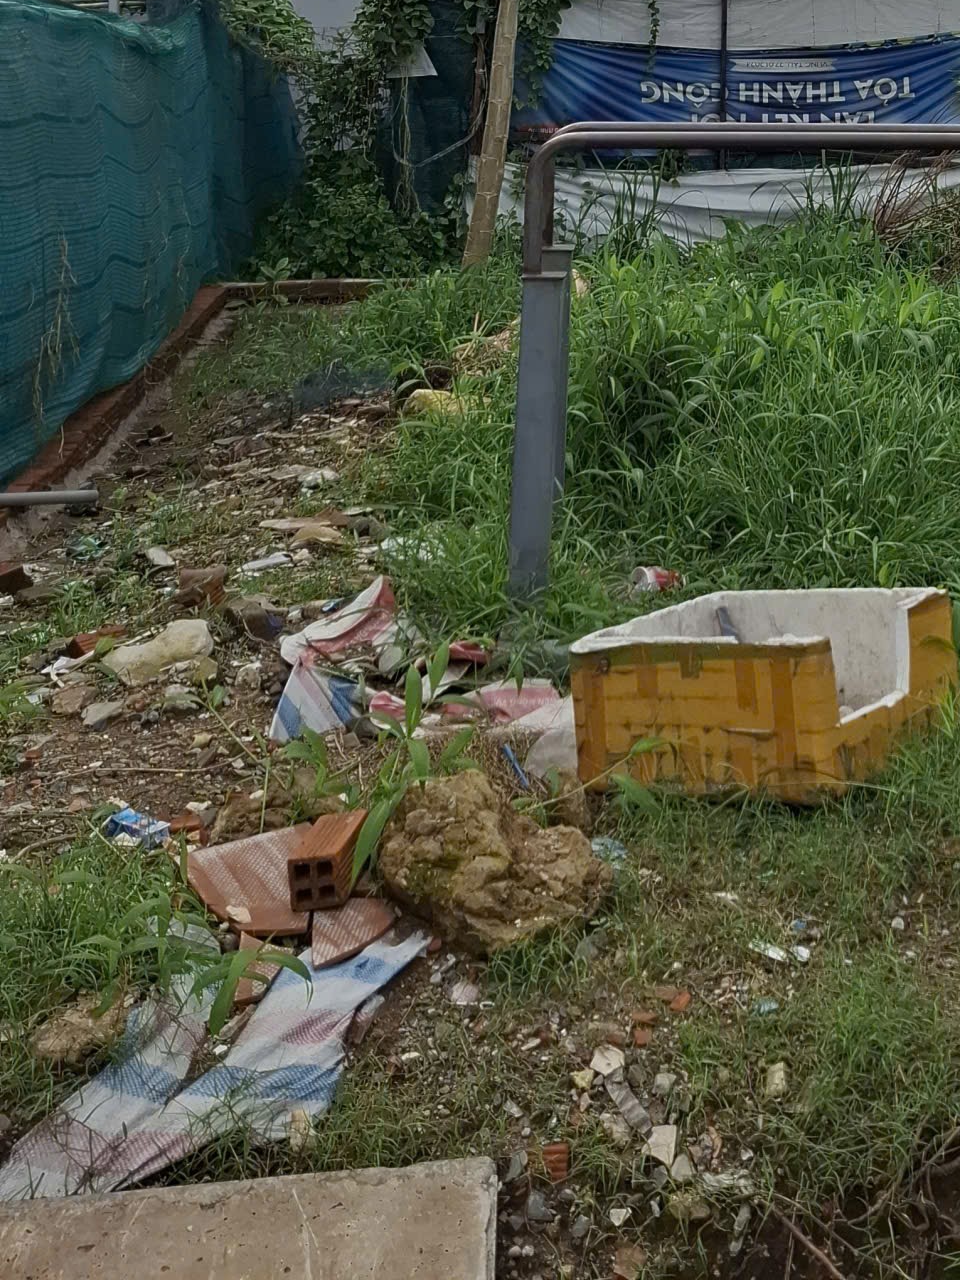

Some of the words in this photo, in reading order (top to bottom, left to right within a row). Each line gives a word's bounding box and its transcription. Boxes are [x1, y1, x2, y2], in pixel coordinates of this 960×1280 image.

[640, 80, 729, 108] CÔNG
[739, 79, 846, 108] THÀNH
[853, 76, 916, 107] TỎA
